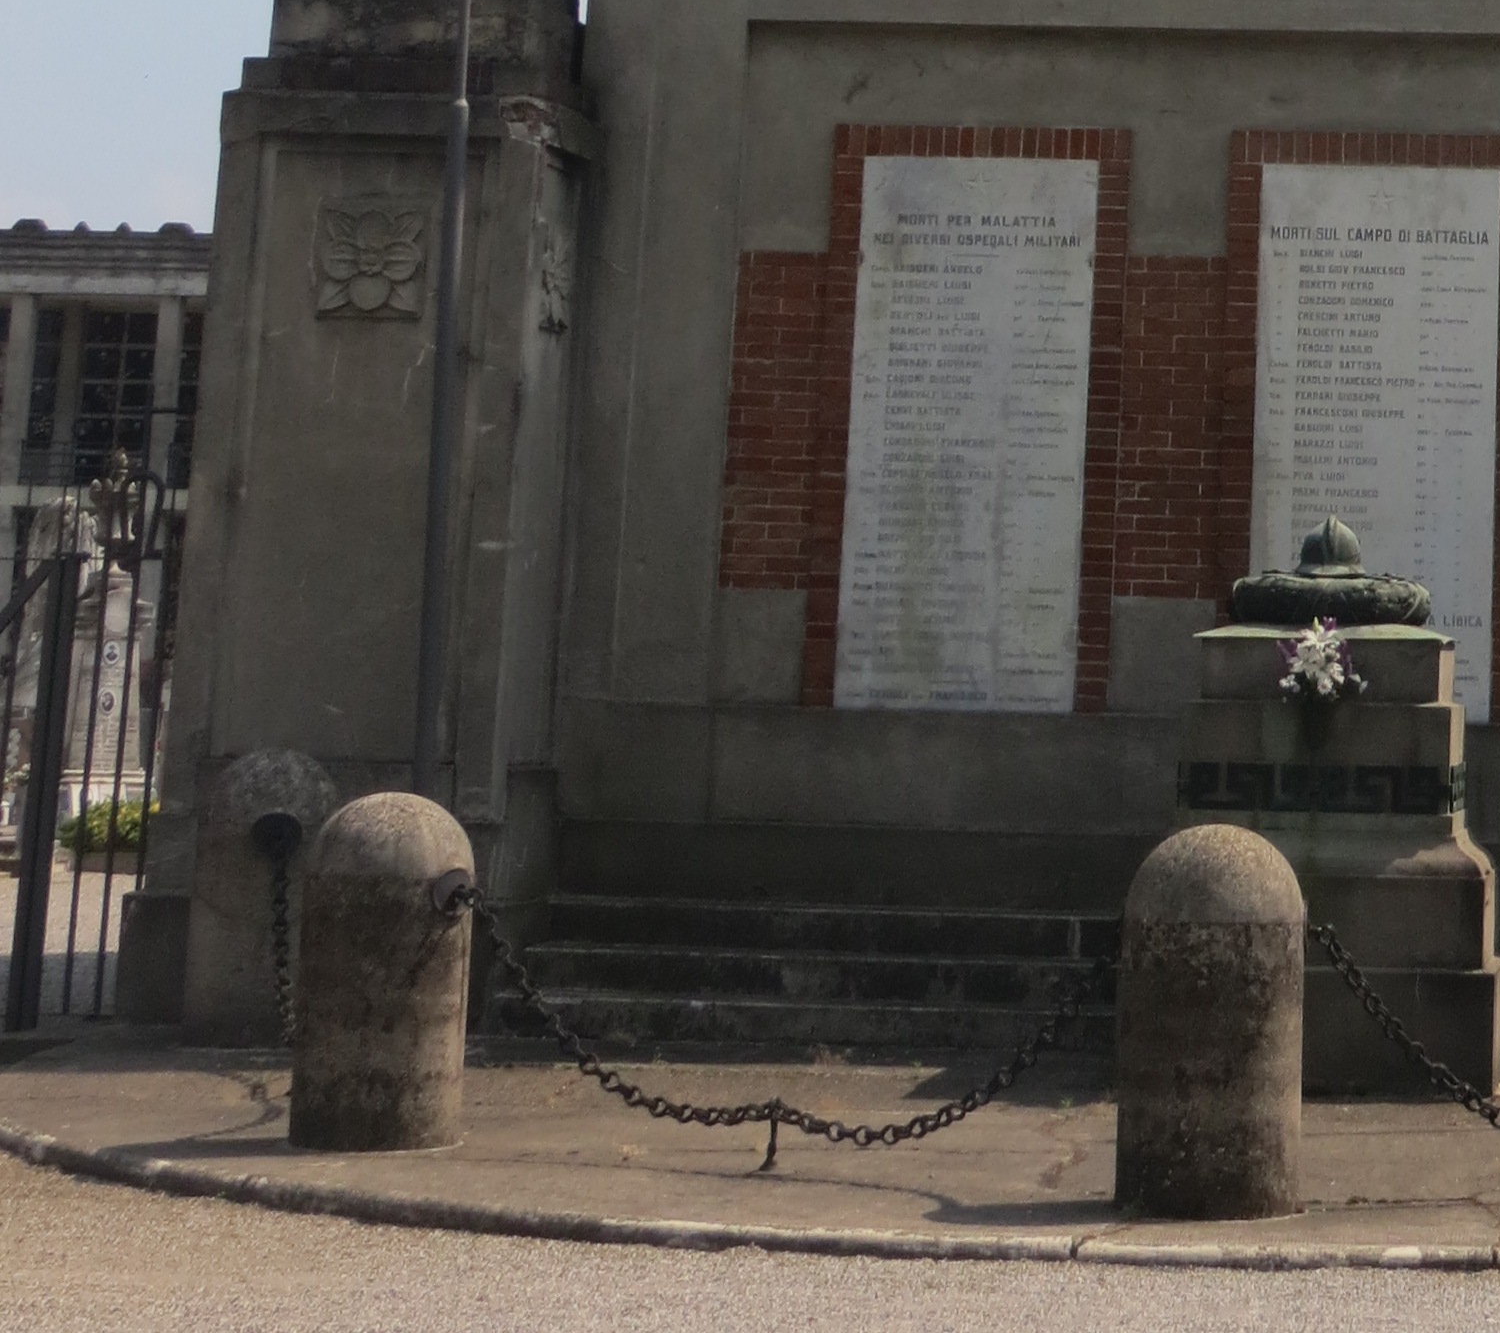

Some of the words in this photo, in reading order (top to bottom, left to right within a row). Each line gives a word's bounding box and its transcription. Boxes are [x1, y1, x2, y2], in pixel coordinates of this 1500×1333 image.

[897, 213, 939, 226] MORTI
[948, 214, 972, 226] PER
[981, 215, 1057, 228] MALATTIA
[1271, 225, 1312, 240] MORTI
[1316, 227, 1341, 241] SUL
[1347, 227, 1393, 243] CAMPO
[1398, 229, 1411, 244] DI
[1416, 229, 1490, 245] BATTAGLIA
[957, 234, 1019, 247] OSPEDALI
[1024, 234, 1082, 248] MILITARI
[1341, 249, 1364, 259] LUIGI
[1353, 265, 1407, 276] FRANCESCO
[1339, 360, 1383, 371] BATTISTA
[1334, 376, 1383, 387] FRANCESCO
